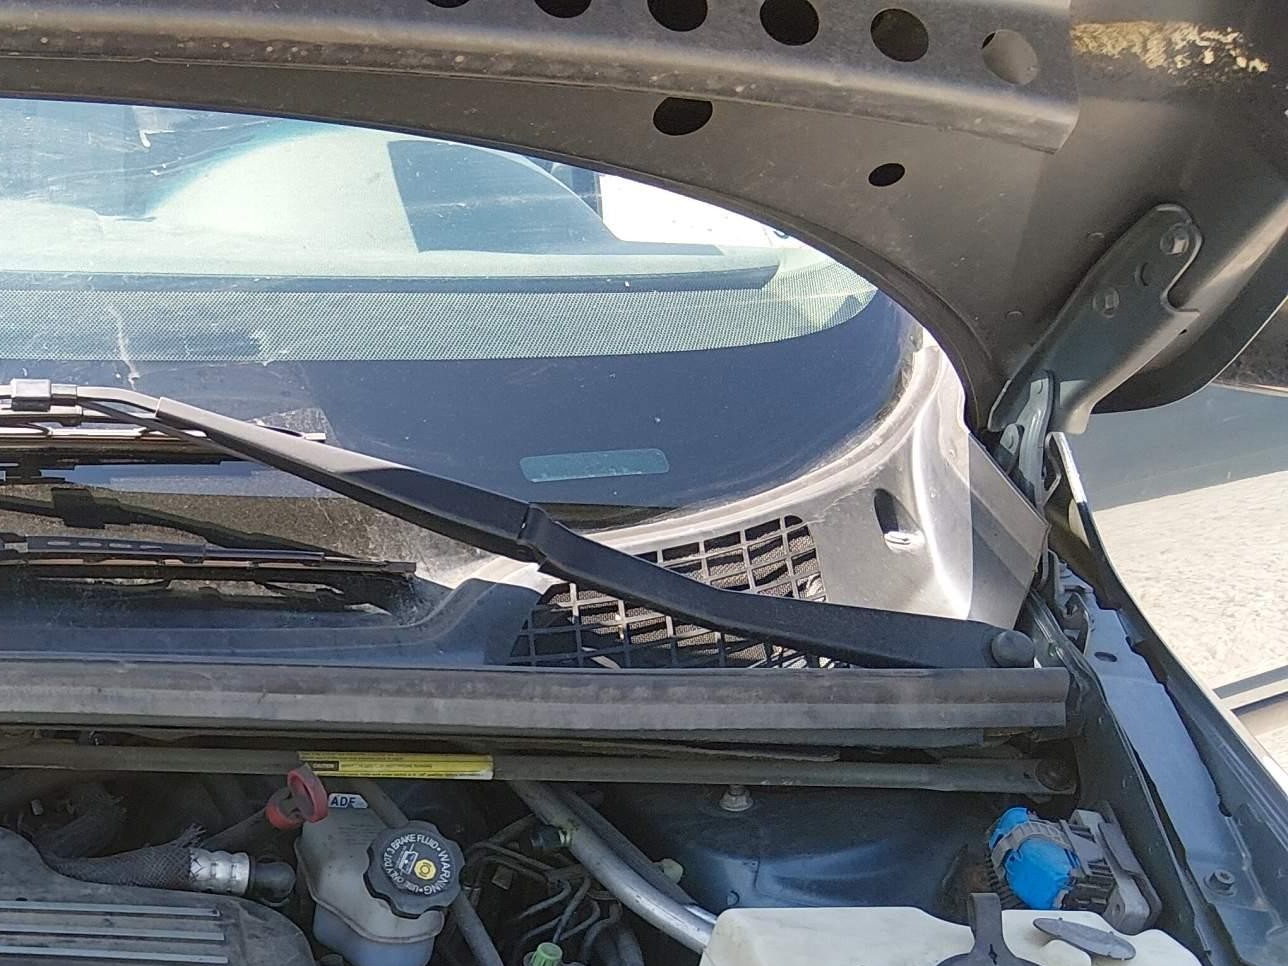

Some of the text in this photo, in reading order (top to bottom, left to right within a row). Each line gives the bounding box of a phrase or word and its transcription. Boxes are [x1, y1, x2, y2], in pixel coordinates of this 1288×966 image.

[390, 833, 417, 851] BRAKE
[416, 834, 439, 850] FLUID
[423, 849, 451, 896] WARNING
